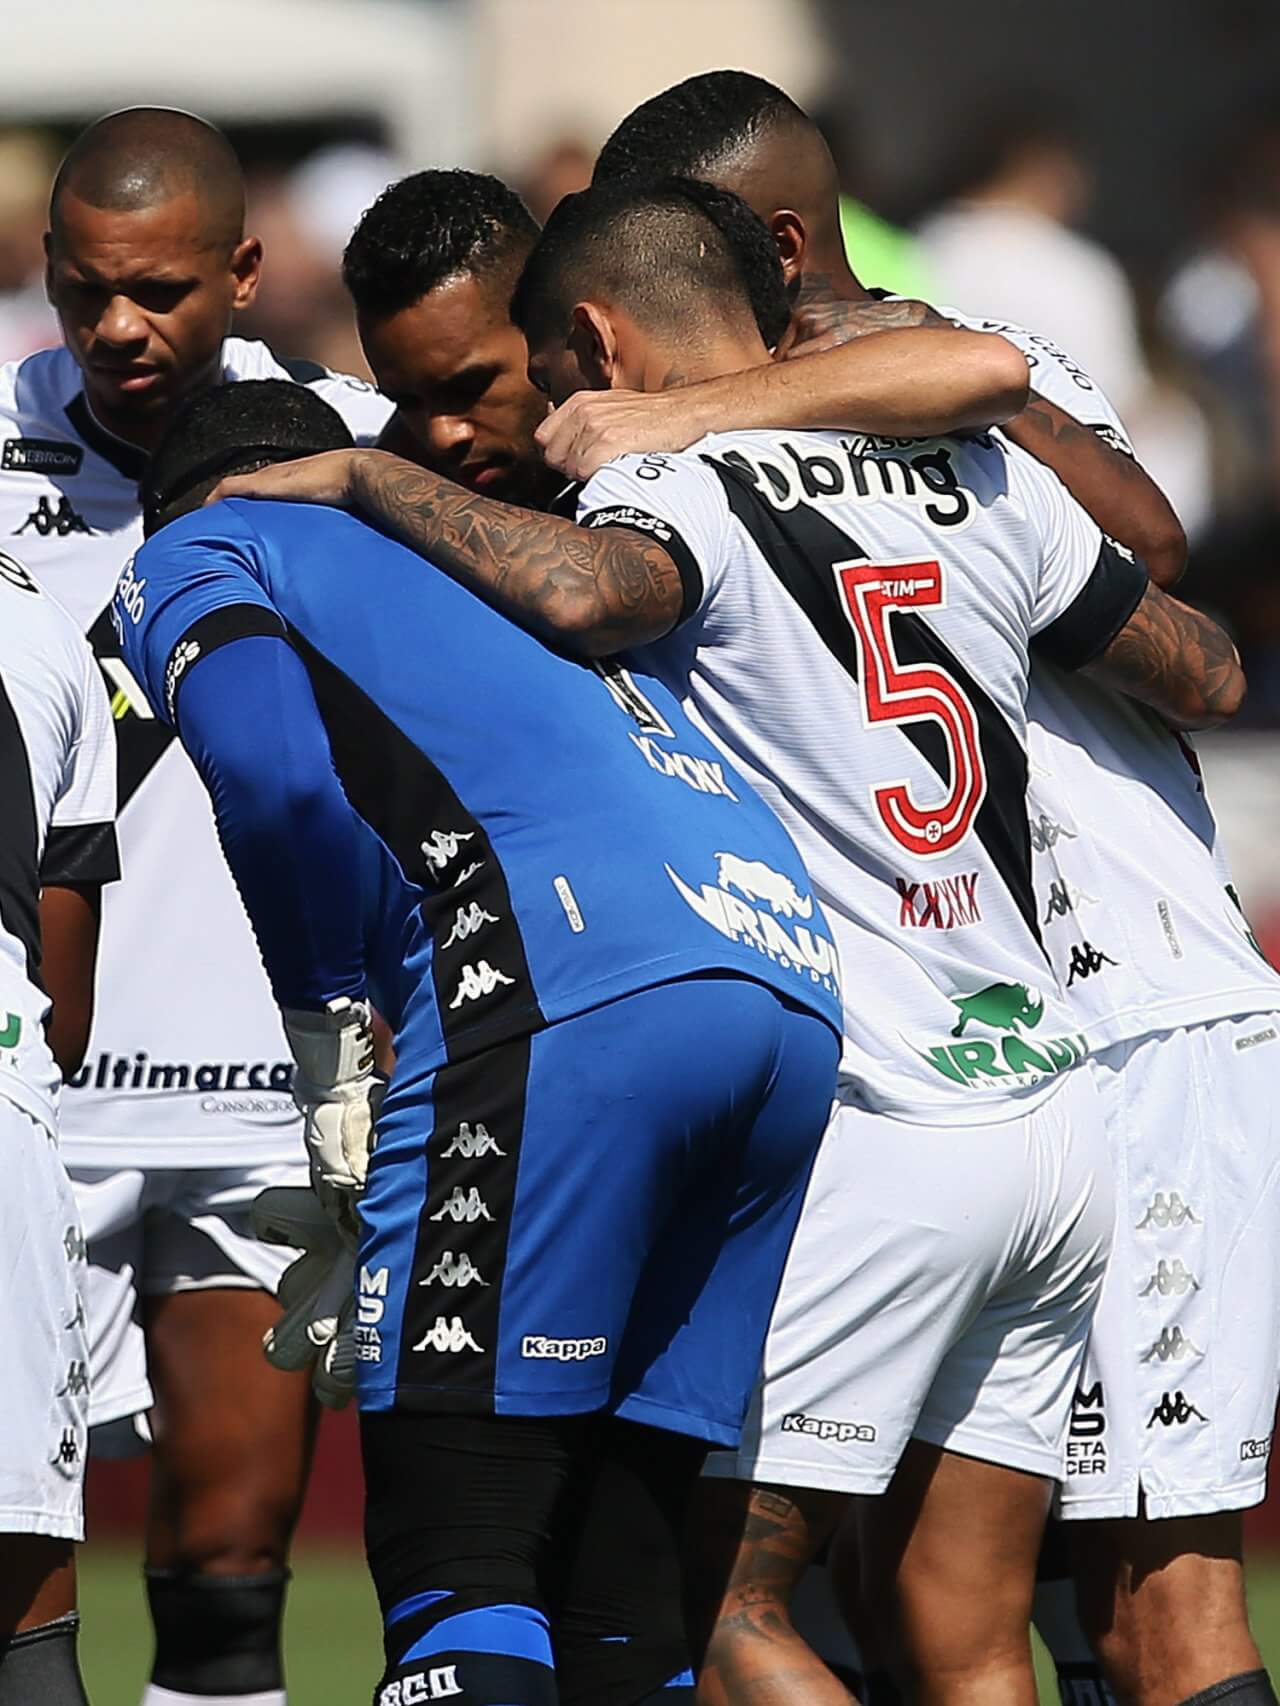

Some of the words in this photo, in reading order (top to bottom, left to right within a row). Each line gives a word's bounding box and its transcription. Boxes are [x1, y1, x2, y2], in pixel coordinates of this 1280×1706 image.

[781, 442, 970, 527] bmg
[884, 578, 915, 597] TIM
[832, 558, 989, 861] 5
[522, 1337, 607, 1361] Kappa
[782, 1413, 876, 1443] Kappa
